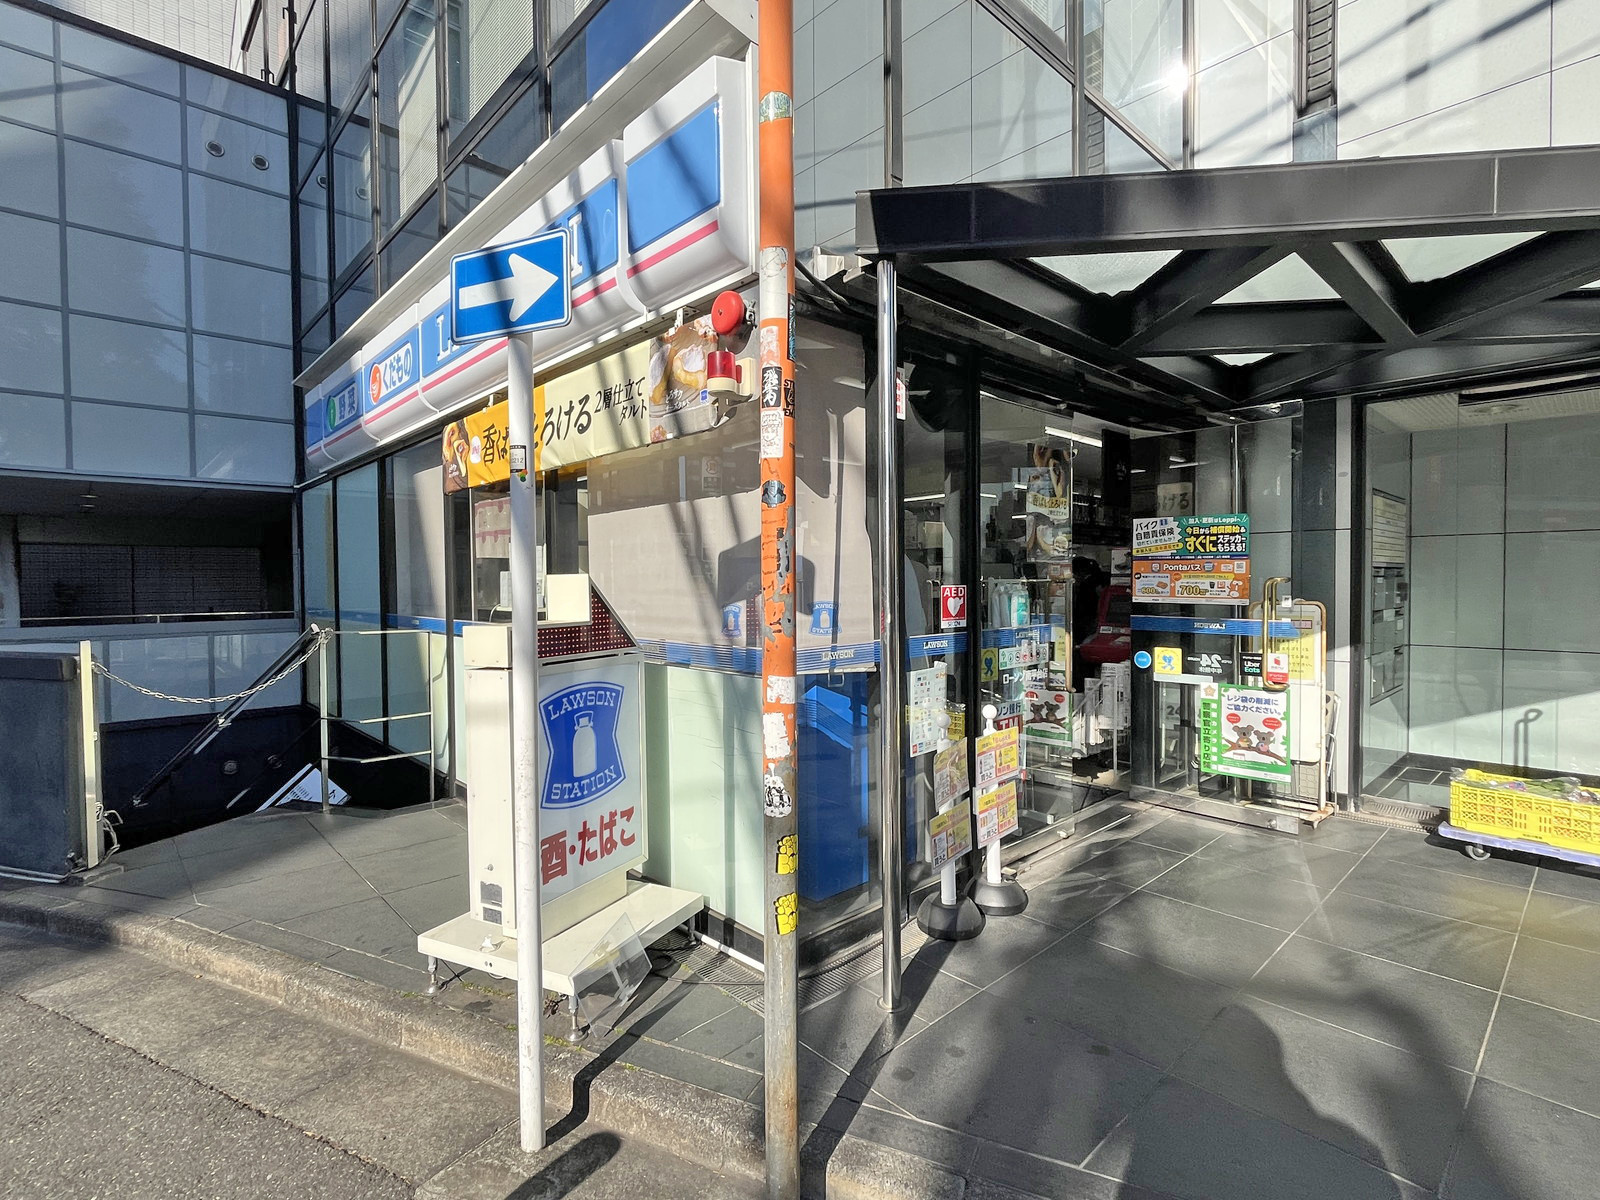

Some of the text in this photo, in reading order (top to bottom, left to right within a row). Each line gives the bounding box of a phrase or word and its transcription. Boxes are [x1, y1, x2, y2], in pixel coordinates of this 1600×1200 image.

[383, 348, 412, 391] くだもの
[594, 377, 646, 414] 2層仕立て
[338, 387, 357, 421] 野菜
[619, 399, 648, 426] タルト
[1135, 520, 1158, 531] バイク
[1185, 535, 1217, 552] すぐに
[1217, 535, 1246, 543] ステッカー
[1217, 543, 1246, 552] もらえる!
[944, 587, 965, 597] AED
[923, 640, 949, 650] LAWSON
[822, 650, 855, 661] LAWSON
[548, 690, 616, 721] LAWSON
[1227, 694, 1279, 706] レジ袋の削減に
[1226, 703, 1281, 715] ご協力ください。
[551, 764, 618, 800] STATION
